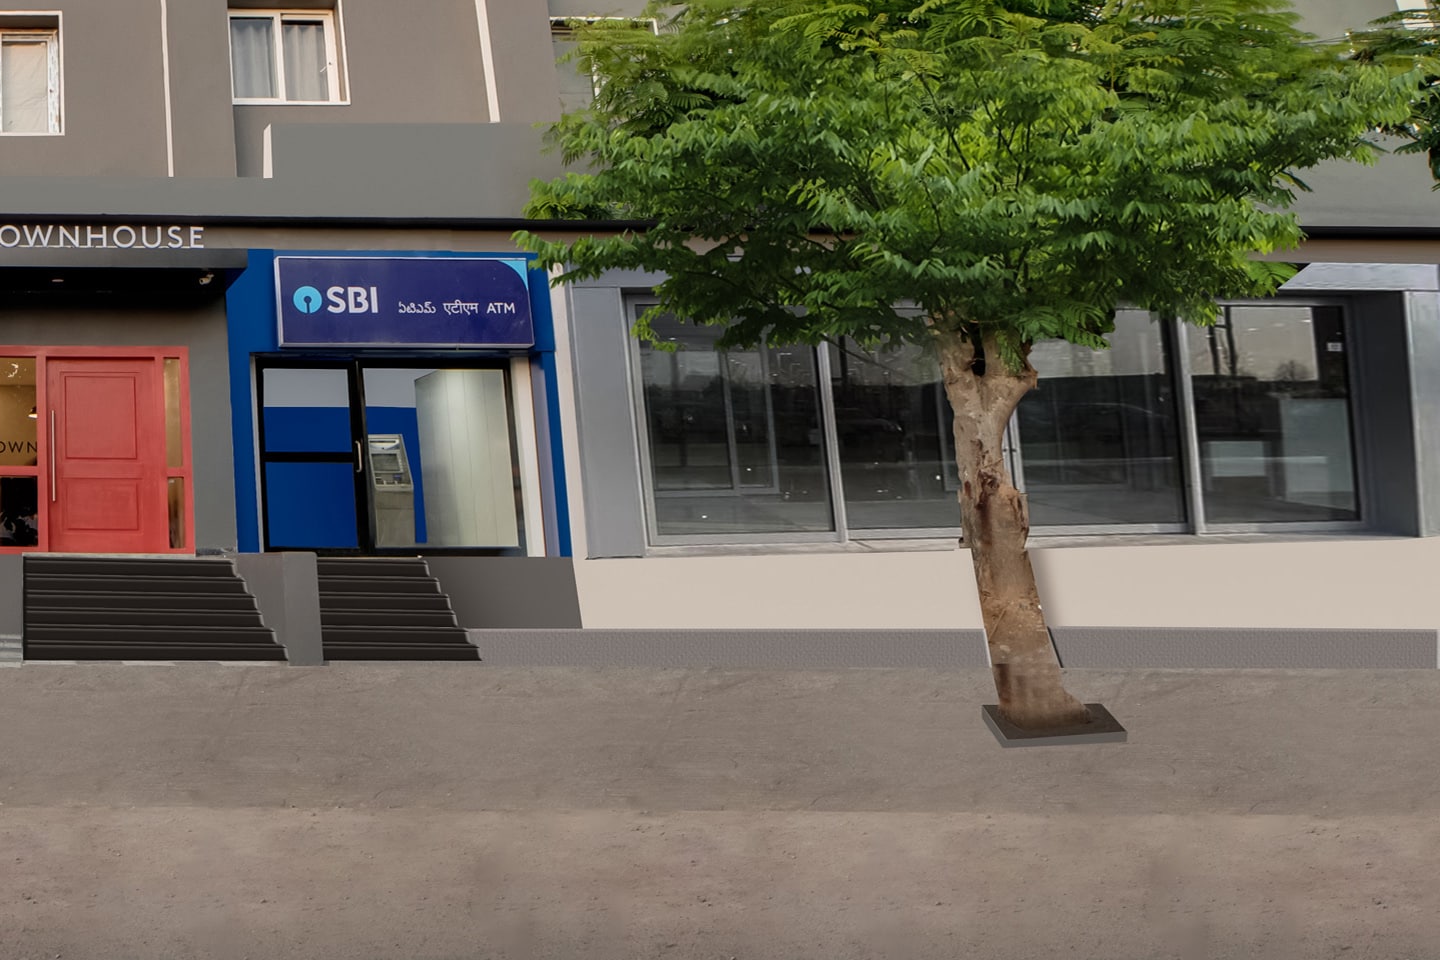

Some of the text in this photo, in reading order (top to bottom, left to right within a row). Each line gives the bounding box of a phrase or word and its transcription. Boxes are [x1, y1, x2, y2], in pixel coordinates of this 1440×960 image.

[326, 286, 379, 314] SBI
[442, 299, 479, 315] एटीएम
[486, 302, 516, 314] ATM
